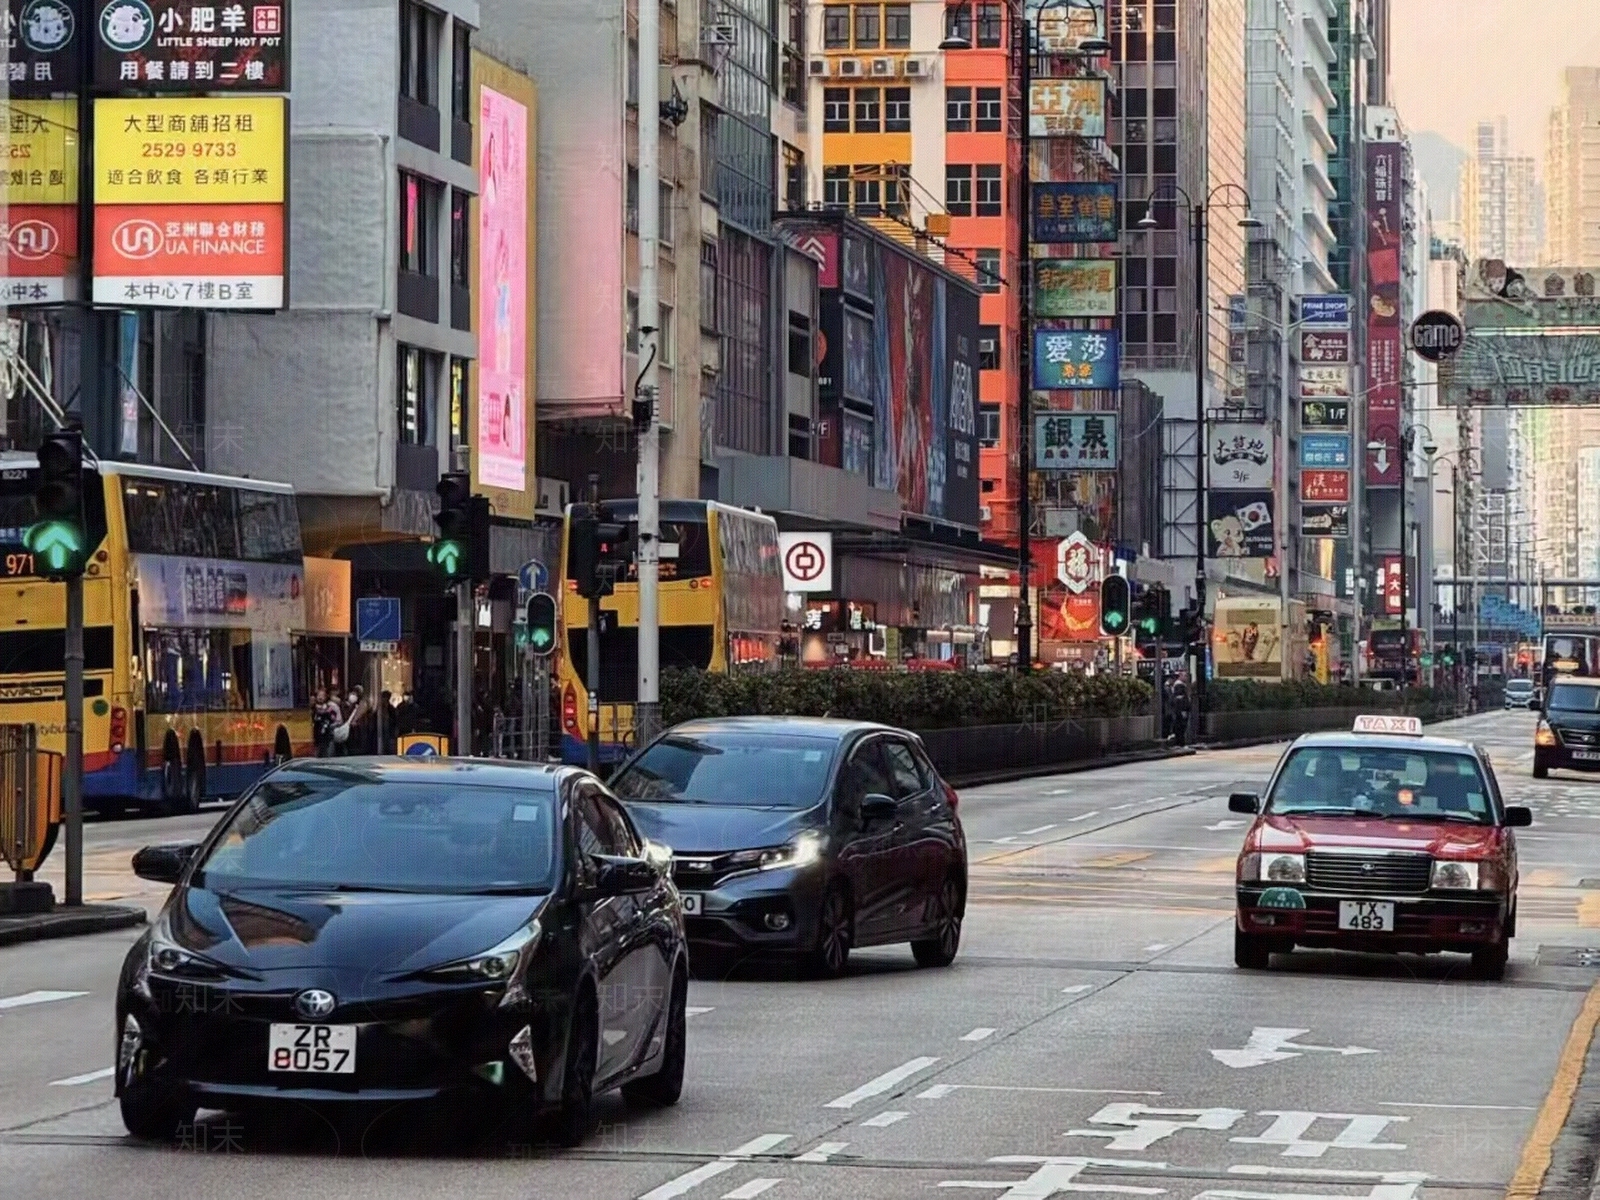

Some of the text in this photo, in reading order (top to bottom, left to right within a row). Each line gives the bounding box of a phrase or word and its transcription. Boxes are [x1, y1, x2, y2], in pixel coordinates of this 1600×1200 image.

[158, 4, 247, 33] 小肥羊
[157, 37, 281, 47] LITTLE SHEEP HOT POT
[119, 61, 265, 81] 用餐請到二樓
[1031, 80, 1101, 116] 亞洲
[124, 114, 254, 133] 大型商舖招租
[142, 142, 237, 158] 2529 9733
[107, 168, 269, 186] 適合飲食 各類行業
[165, 221, 266, 237] 亞洲聯合財務
[165, 239, 265, 255] UA FINANCE
[124, 281, 254, 300] 本中心7樓B室
[1046, 334, 1107, 363] 愛莎
[1325, 350, 1343, 360] 3/F
[1329, 408, 1347, 420] 1/F
[1042, 417, 1108, 449] 銀泉
[6, 554, 35, 575] 971
[1360, 719, 1417, 733] TAXI
[1357, 903, 1378, 917] TX
[1349, 917, 1385, 930] 483
[294, 1025, 331, 1048] ZR
[274, 1047, 350, 1072] 8057
